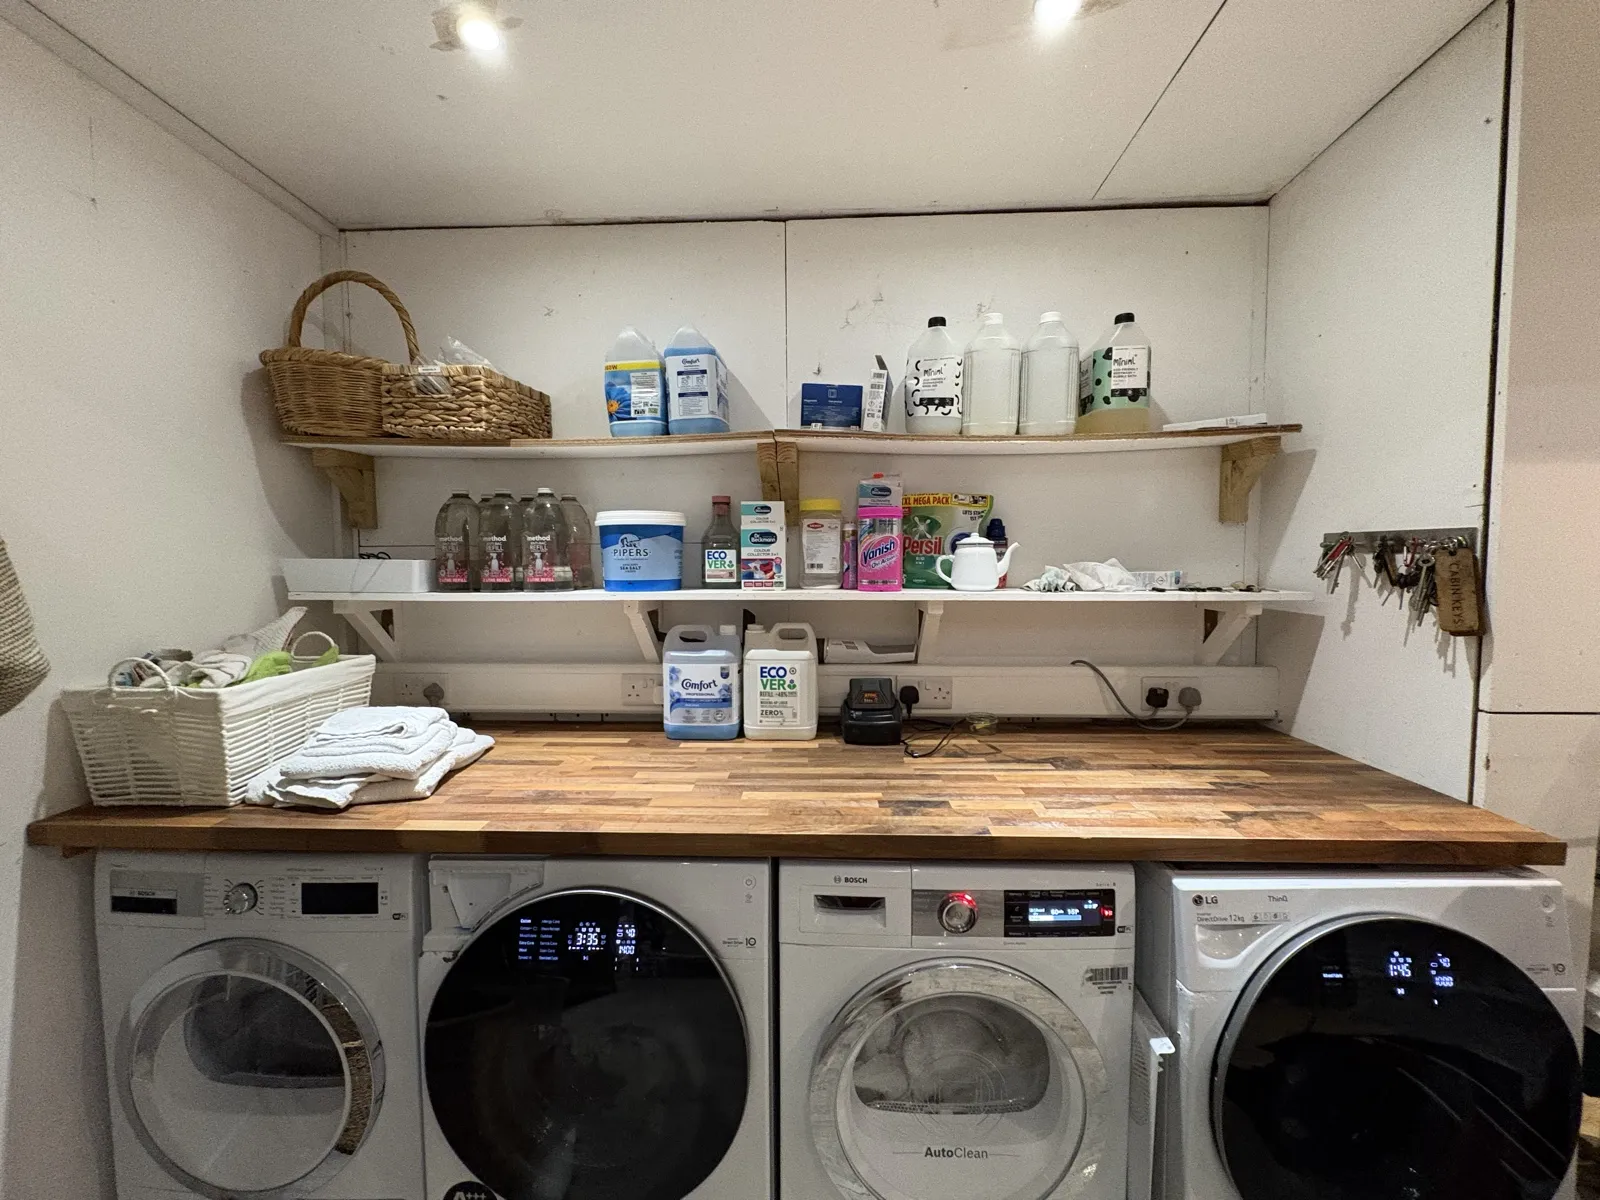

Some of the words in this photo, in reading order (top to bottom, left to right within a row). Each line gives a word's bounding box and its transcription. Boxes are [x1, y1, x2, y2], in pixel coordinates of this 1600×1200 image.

[913, 496, 931, 505] MEGA
[933, 496, 950, 505] PACK
[863, 538, 895, 565] Vanish
[903, 536, 943, 556] Persil
[613, 548, 649, 557] PIPERS
[707, 550, 727, 560] ECO
[707, 560, 727, 569] VER
[1449, 561, 1463, 595] CABIN
[1452, 599, 1465, 625] KEYS
[760, 666, 787, 679] ECO
[681, 678, 718, 691] Comfort
[760, 678, 787, 690] VER
[1205, 896, 1219, 904] LG
[1229, 914, 1245, 923] 12kg
[625, 928, 636, 937] 40
[575, 933, 599, 945] 3:35
[618, 945, 635, 954] 1400
[1389, 963, 1412, 977] 1:45
[924, 1146, 988, 1159] AutoClean
